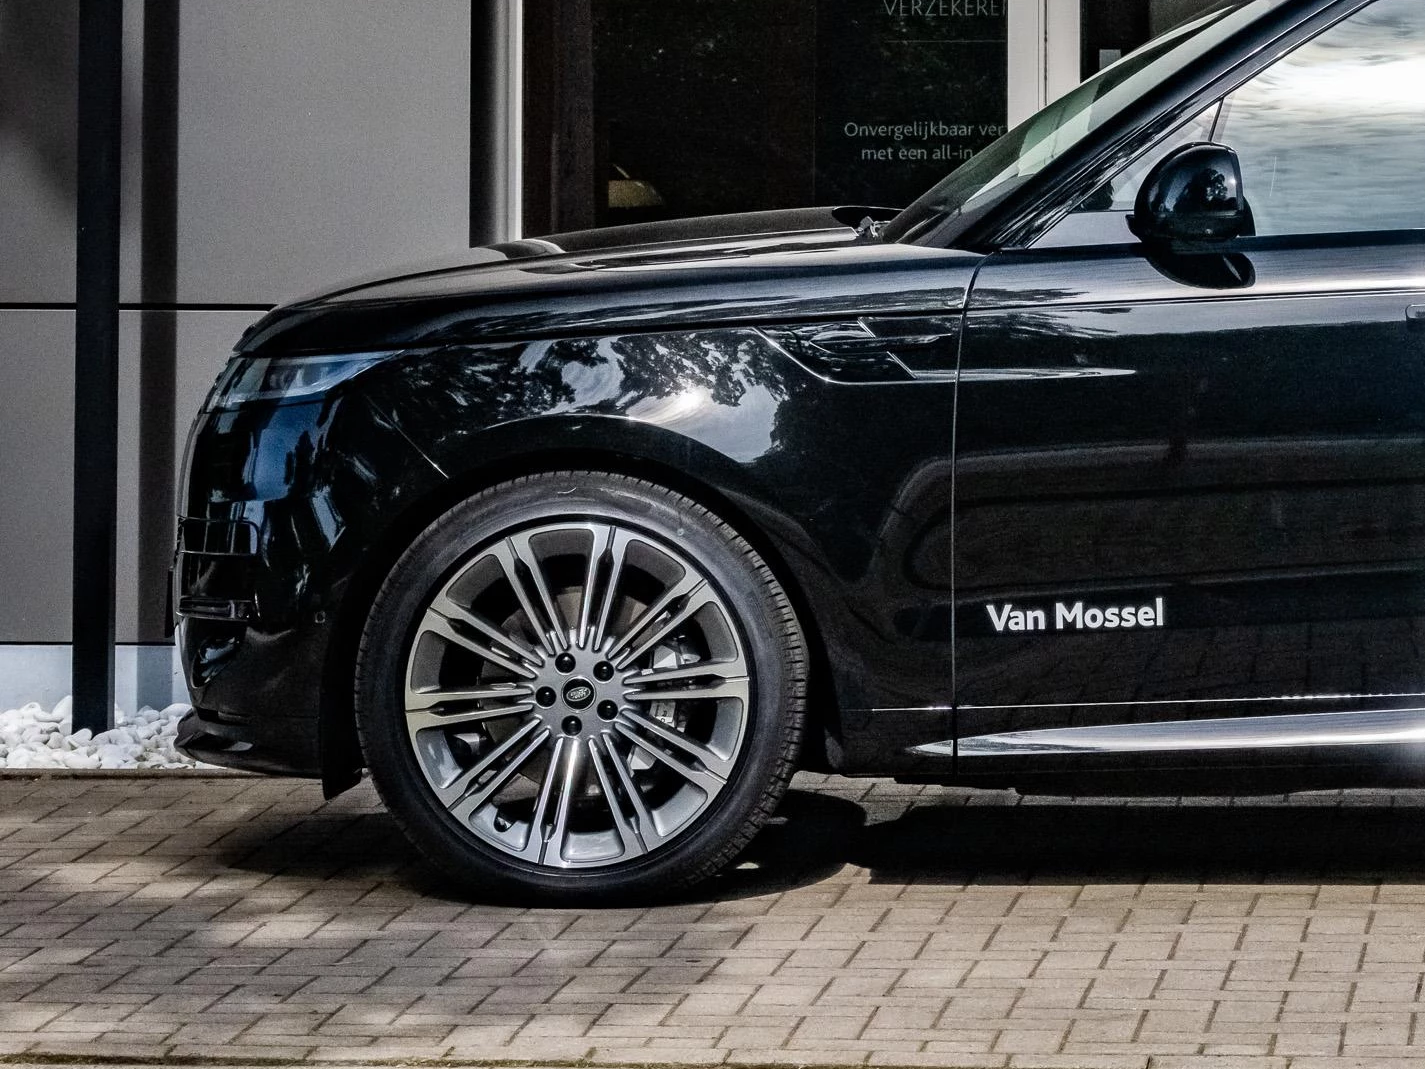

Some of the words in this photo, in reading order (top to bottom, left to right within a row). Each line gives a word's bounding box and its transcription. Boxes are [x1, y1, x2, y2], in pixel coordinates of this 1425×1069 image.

[844, 121, 974, 141] Onvergelijkbaar
[979, 124, 1007, 136] ver
[861, 146, 894, 160] met
[899, 147, 927, 160] een
[932, 144, 973, 160] all-in
[986, 604, 1045, 632] Van
[1055, 597, 1164, 629] Mossel
